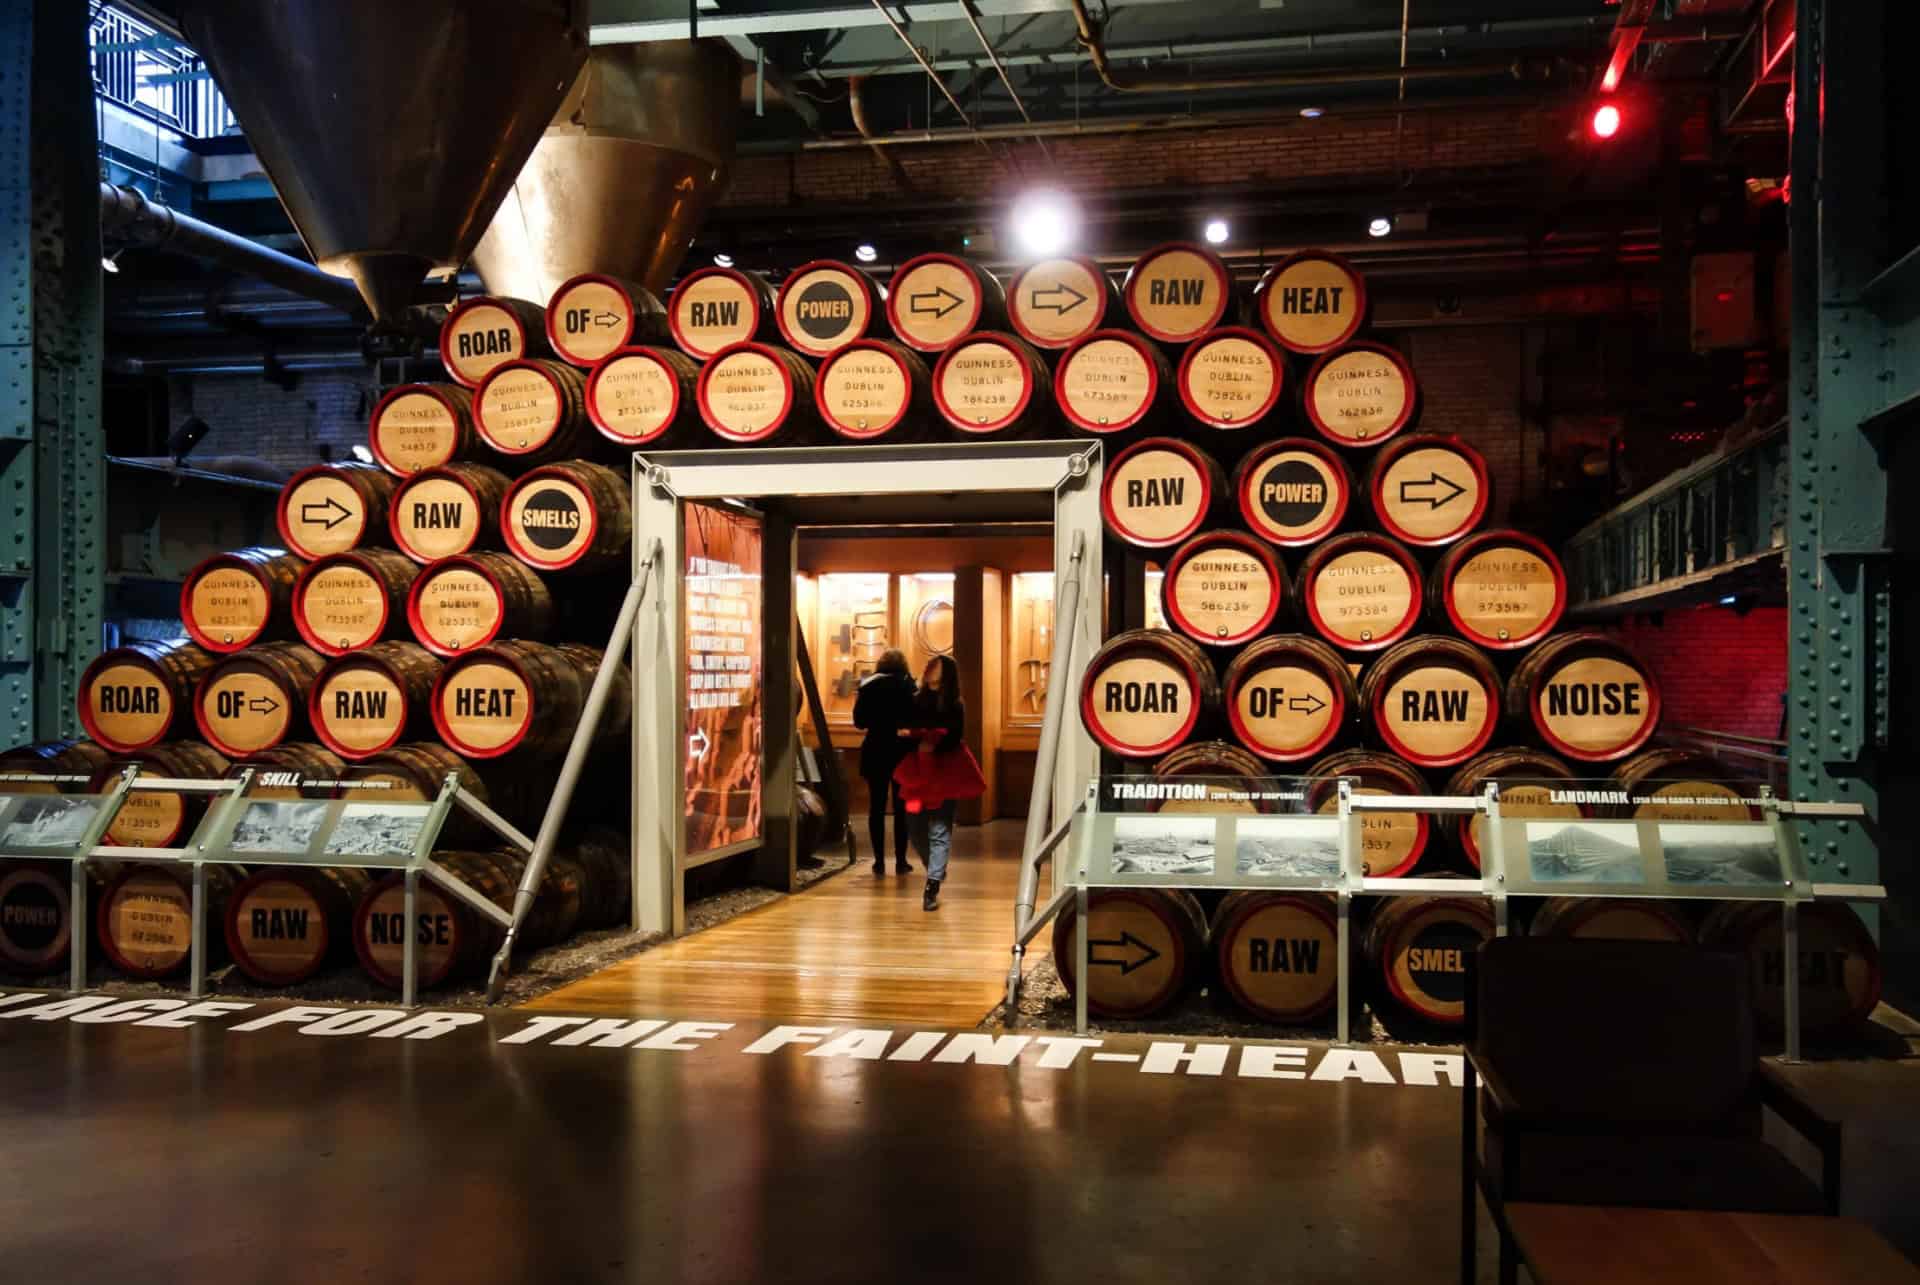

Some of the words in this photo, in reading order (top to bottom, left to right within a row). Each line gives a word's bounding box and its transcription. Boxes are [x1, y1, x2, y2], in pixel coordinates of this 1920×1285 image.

[1151, 280, 1204, 305] RAW
[1282, 287, 1344, 314] HEAT
[691, 302, 739, 326] RAW
[800, 299, 849, 319] POWER
[566, 309, 590, 333] OF
[458, 328, 511, 358] ROAR
[956, 359, 1014, 370] GUINNESS
[1202, 354, 1264, 365] GUINNESS
[719, 368, 773, 377] GUINNESS
[963, 376, 1004, 385] DUBLIN
[1209, 371, 1252, 382] DUBLIN
[1328, 368, 1390, 381] GUINNESS
[726, 385, 766, 394] DUBLIN
[845, 382, 884, 391] DUBLIN
[1337, 387, 1382, 398] DUBLIN
[1128, 478, 1184, 507] RAW
[1264, 482, 1323, 504] POWER
[413, 503, 462, 529] RAW
[523, 509, 580, 529] SMELLS
[1192, 563, 1259, 573] GUINNESS
[1328, 566, 1397, 577] GUINNESS
[1470, 562, 1538, 573] GUINNESS
[203, 580, 256, 589] GUINNESS
[317, 579, 371, 589] GUINNESS
[432, 583, 486, 593] GUINNESS
[1201, 581, 1248, 592] DUBLIN
[1339, 584, 1386, 596] DUBLIN
[210, 597, 248, 606] DUBLIN
[440, 601, 480, 609] DUBLIN
[100, 685, 160, 714] ROAR
[218, 690, 245, 719] OF
[336, 691, 387, 719] RAW
[455, 688, 516, 718] HEAT
[1105, 682, 1178, 713] ROAR
[1250, 686, 1284, 719] OF
[1402, 690, 1469, 722] RAW
[1549, 682, 1641, 716] NOISE
[260, 772, 300, 786] SKILL
[1112, 784, 1207, 800] TRADITION
[1551, 790, 1630, 804] LANDMARK
[4, 906, 57, 926] POWER
[252, 908, 308, 940] RAW
[371, 912, 449, 945] NOSE
[1249, 938, 1321, 974] RAW
[1408, 948, 1464, 973] SMEL
[0, 993, 256, 1027] ACE
[226, 1006, 485, 1040] FOR
[497, 1016, 736, 1050] THE
